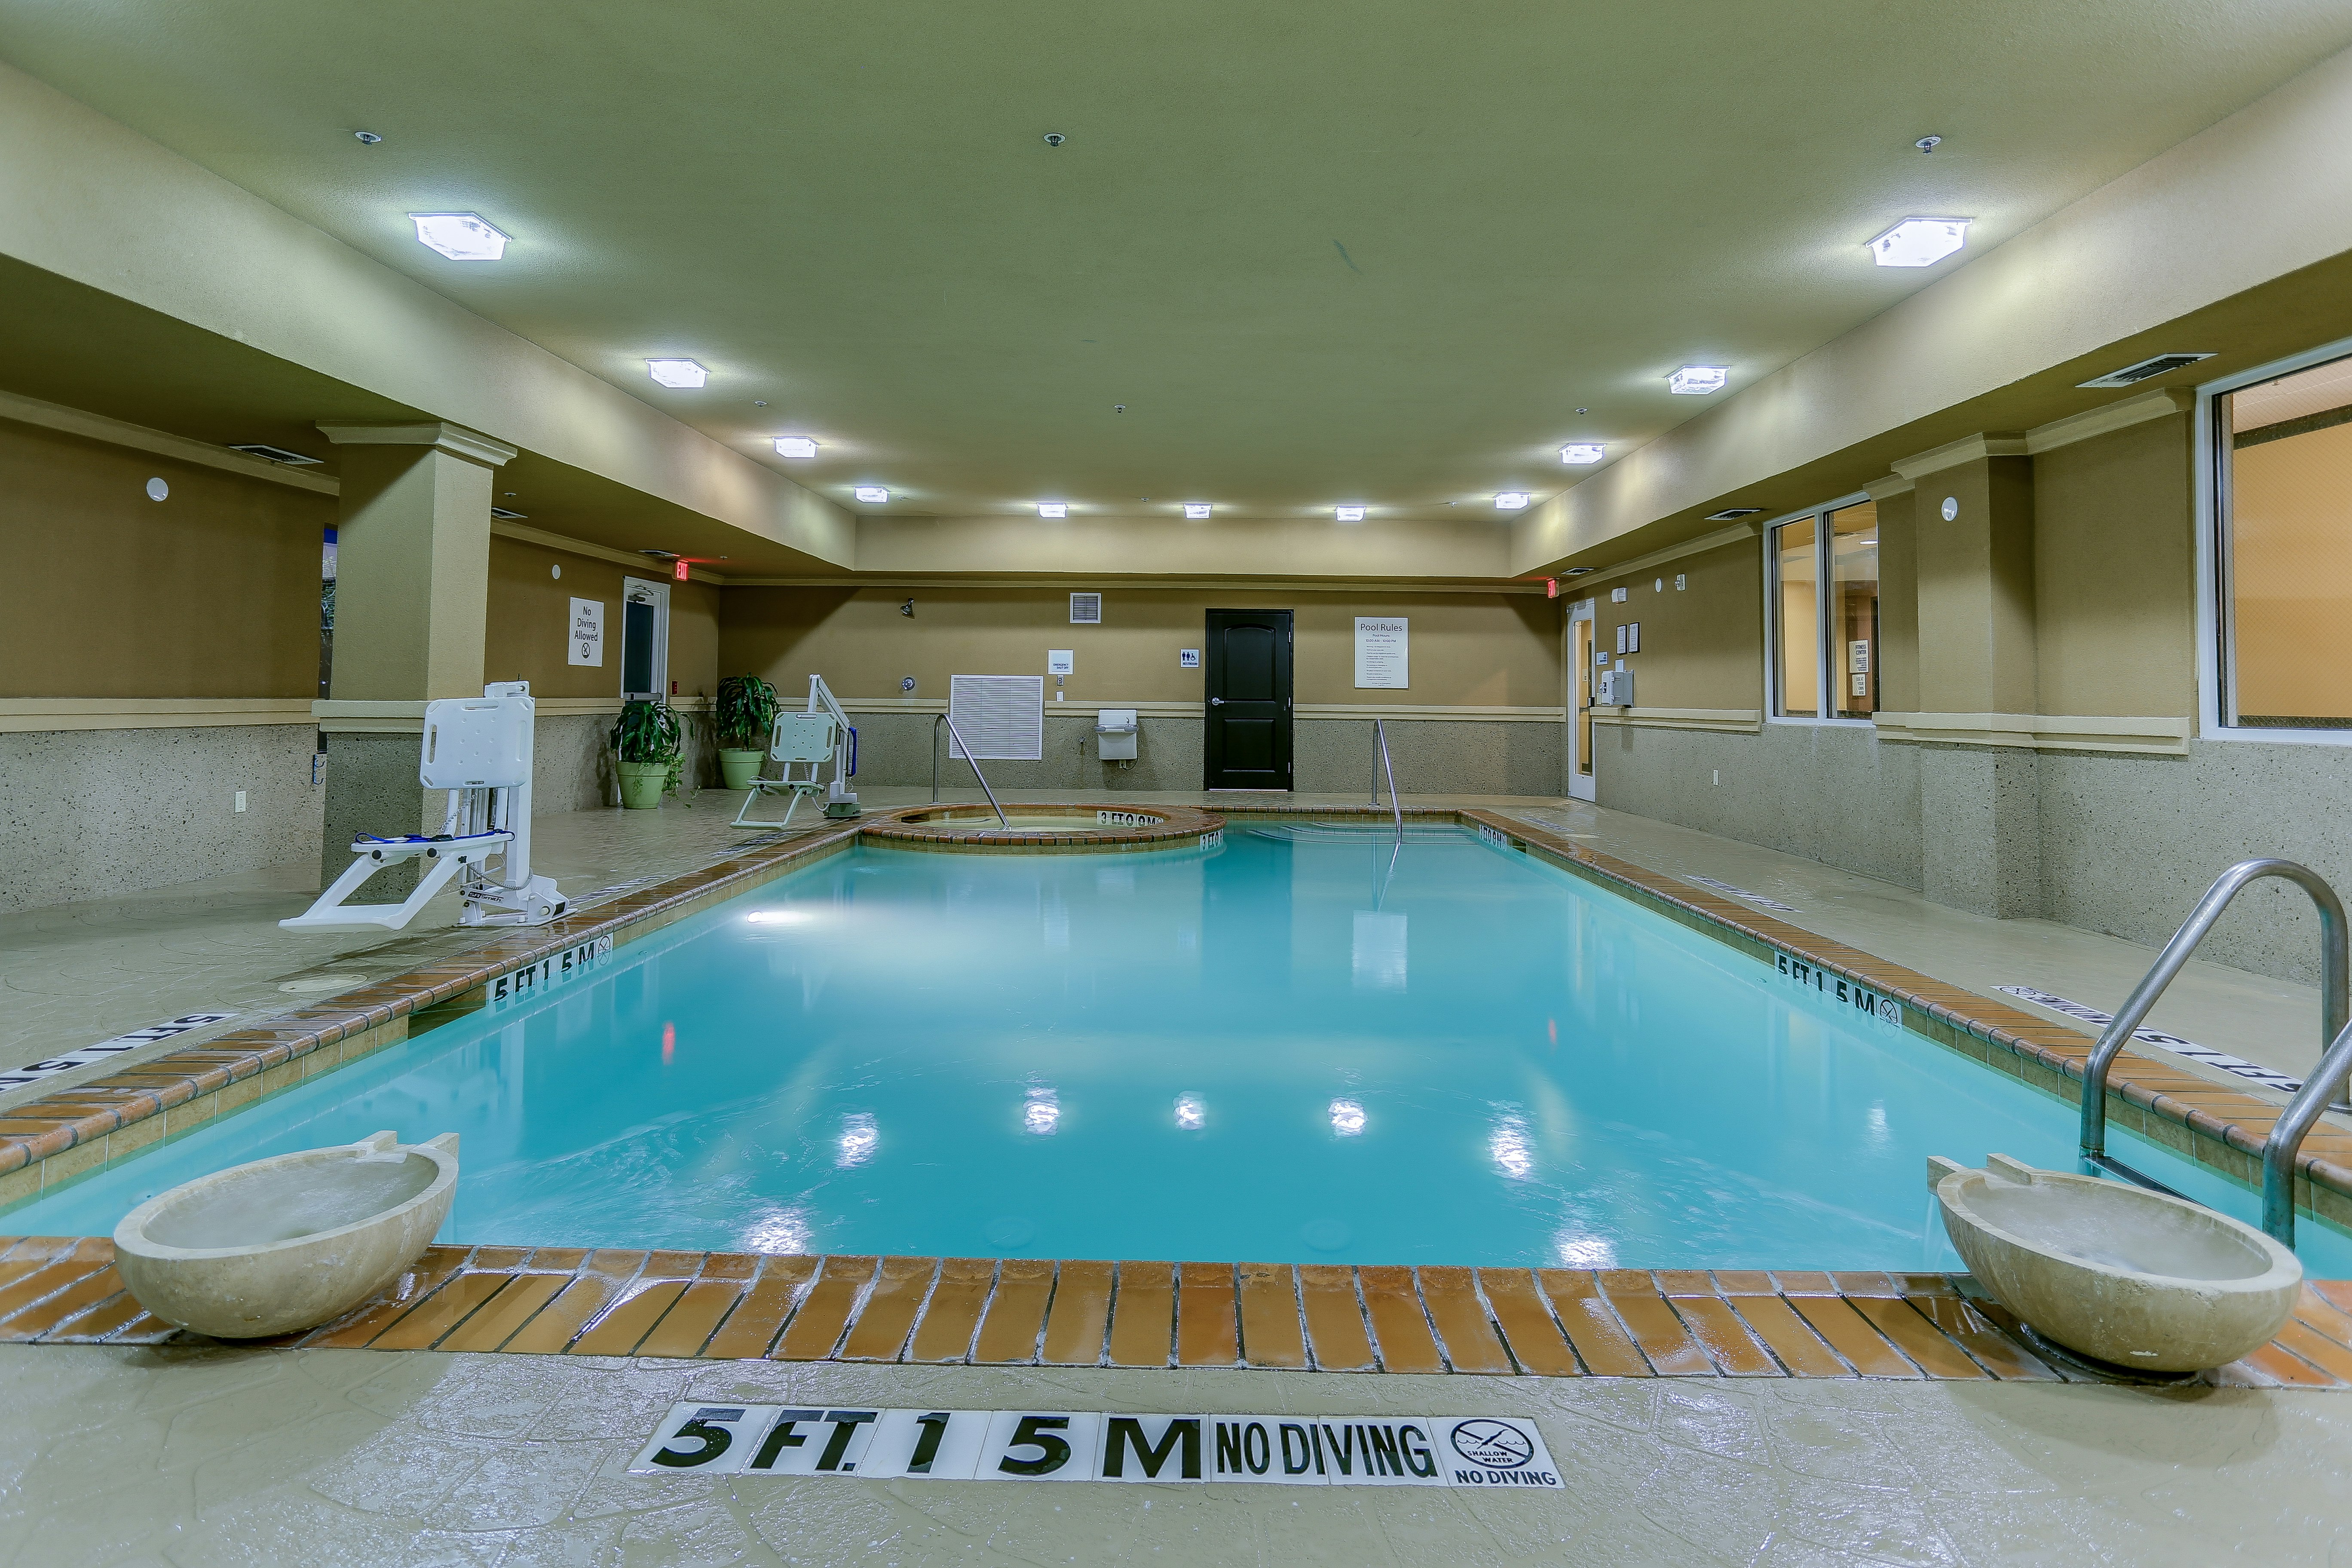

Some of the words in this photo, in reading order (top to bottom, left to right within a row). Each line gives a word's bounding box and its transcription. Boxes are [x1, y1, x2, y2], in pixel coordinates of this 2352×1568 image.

[583, 606, 591, 616] No
[577, 618, 596, 631] Diving
[574, 630, 598, 641] Allowed
[493, 977, 508, 1002] 5
[560, 951, 573, 973] 5
[579, 941, 594, 965] M
[1777, 955, 1788, 975] 5
[1836, 980, 1848, 1003] 5
[1855, 987, 1875, 1017] M
[649, 1408, 747, 1467] 5
[749, 1409, 879, 1472] FT.
[906, 1412, 951, 1473] 1
[997, 1416, 1072, 1476] 5
[1102, 1417, 1202, 1479] M
[1216, 1422, 1270, 1475] NO
[1278, 1423, 1439, 1478] DIVING
[1454, 1470, 1484, 1484] NO
[1485, 1470, 1557, 1486] DIVING
